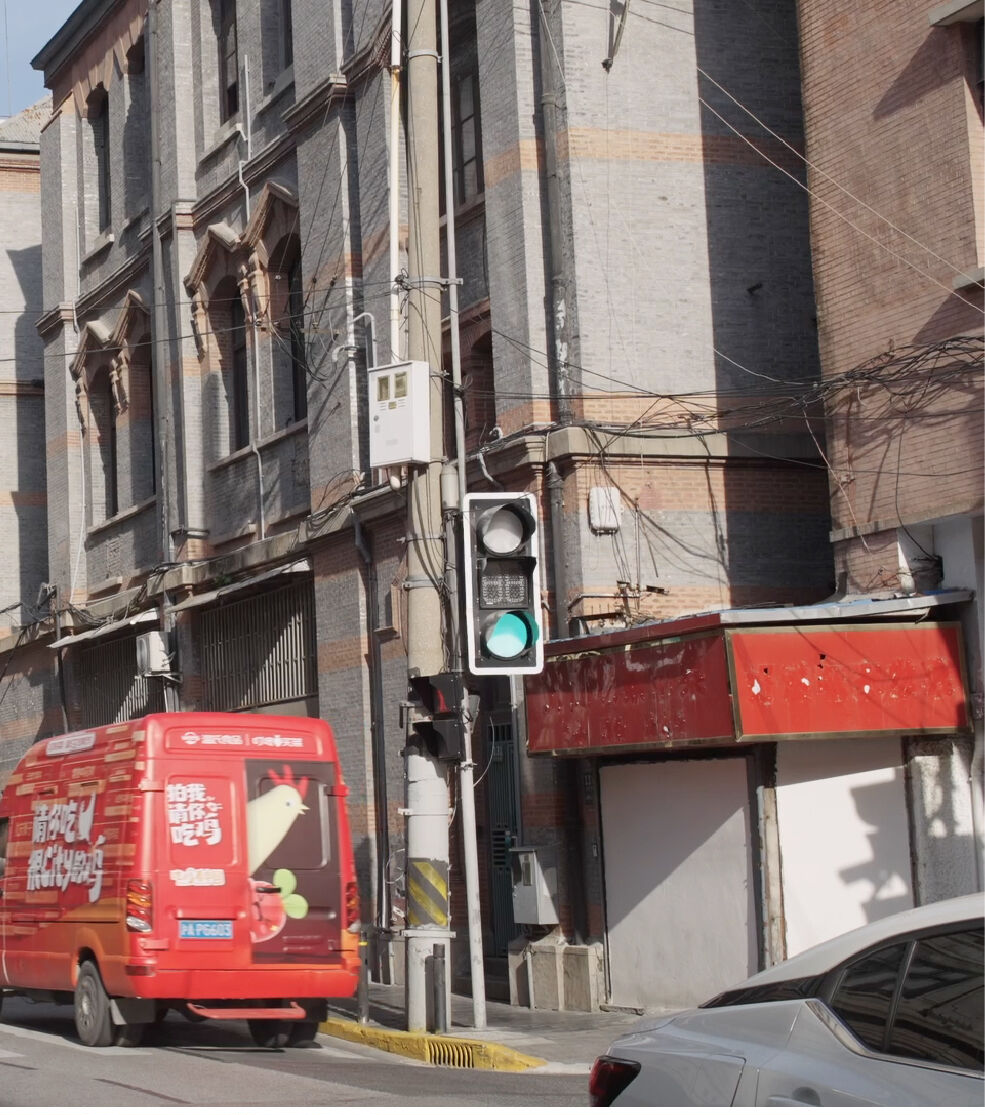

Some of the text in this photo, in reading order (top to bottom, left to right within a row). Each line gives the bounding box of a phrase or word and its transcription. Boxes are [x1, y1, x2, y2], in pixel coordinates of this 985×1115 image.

[32, 799, 78, 844] 请你吃
[167, 803, 206, 823] 请你
[170, 819, 222, 847] 吃鸡
